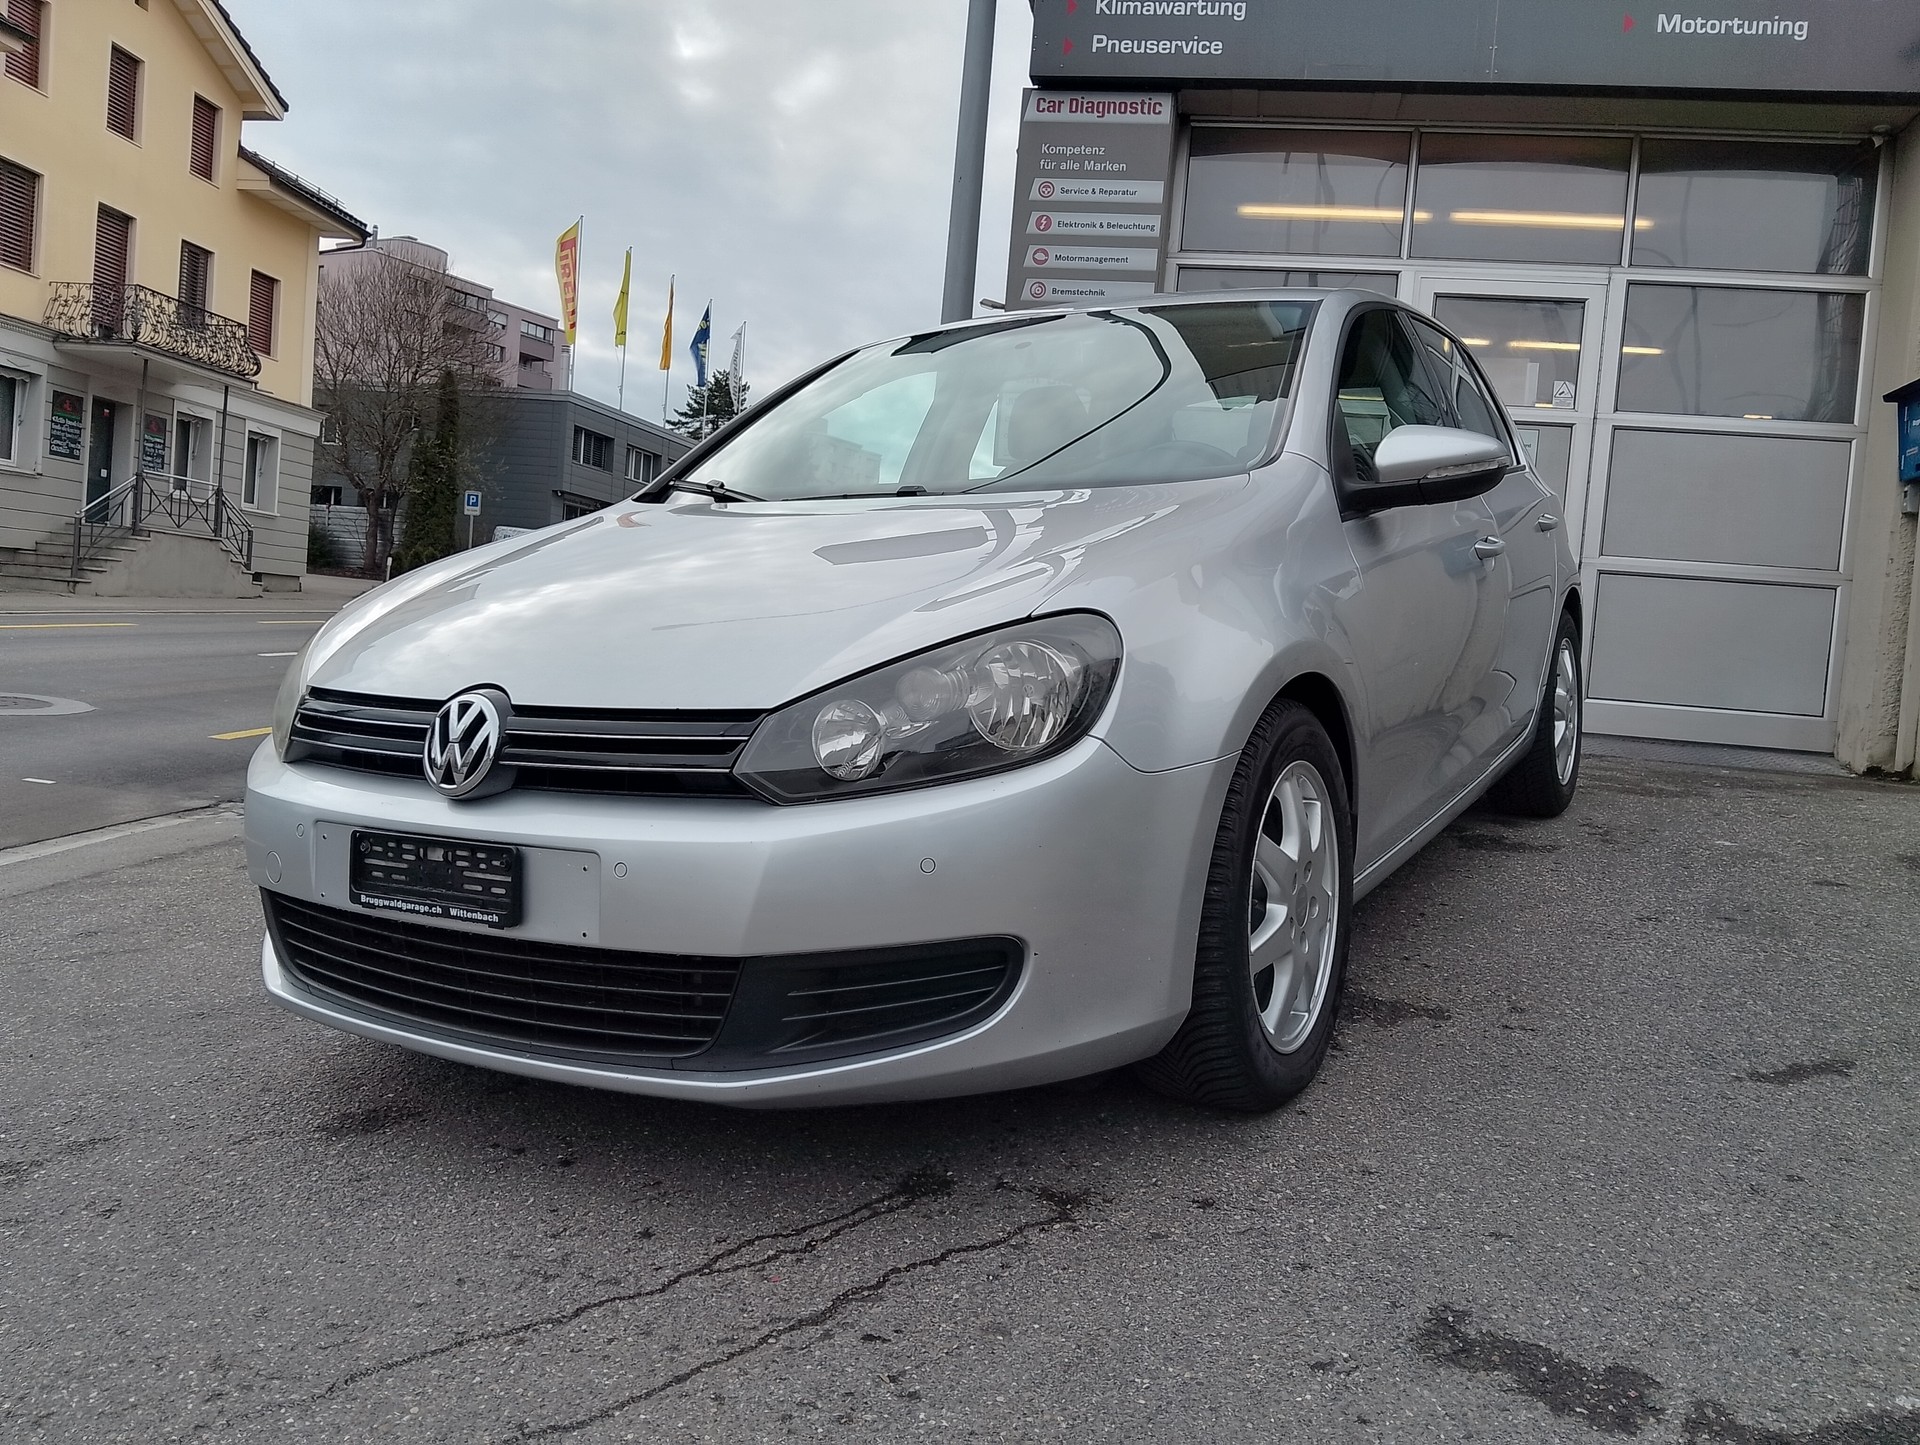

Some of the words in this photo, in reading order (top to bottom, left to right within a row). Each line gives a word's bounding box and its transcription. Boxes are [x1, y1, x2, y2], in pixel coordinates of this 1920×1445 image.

[1095, 0, 1248, 21] Klimawartung
[1656, 13, 1810, 42] Motortuning
[1091, 35, 1224, 56] Pneuservice
[1036, 97, 1065, 116] Car
[1069, 96, 1163, 119] Diagnostic
[1041, 143, 1106, 157] Kompetenz
[1039, 159, 1057, 171] für
[1060, 161, 1080, 171] alle
[1083, 161, 1127, 172] Marken
[1060, 187, 1089, 195] Service
[1098, 188, 1138, 197] Reparatur
[1057, 221, 1097, 229] Elektronik
[1106, 222, 1156, 232] Beleuchtung
[1054, 254, 1129, 265] Motormanagement
[1051, 287, 1106, 297] Bremstechnik
[470, 496, 476, 505] P
[360, 894, 443, 915] Bruggwaldgarage.ch
[449, 907, 500, 923] Wittenbach
